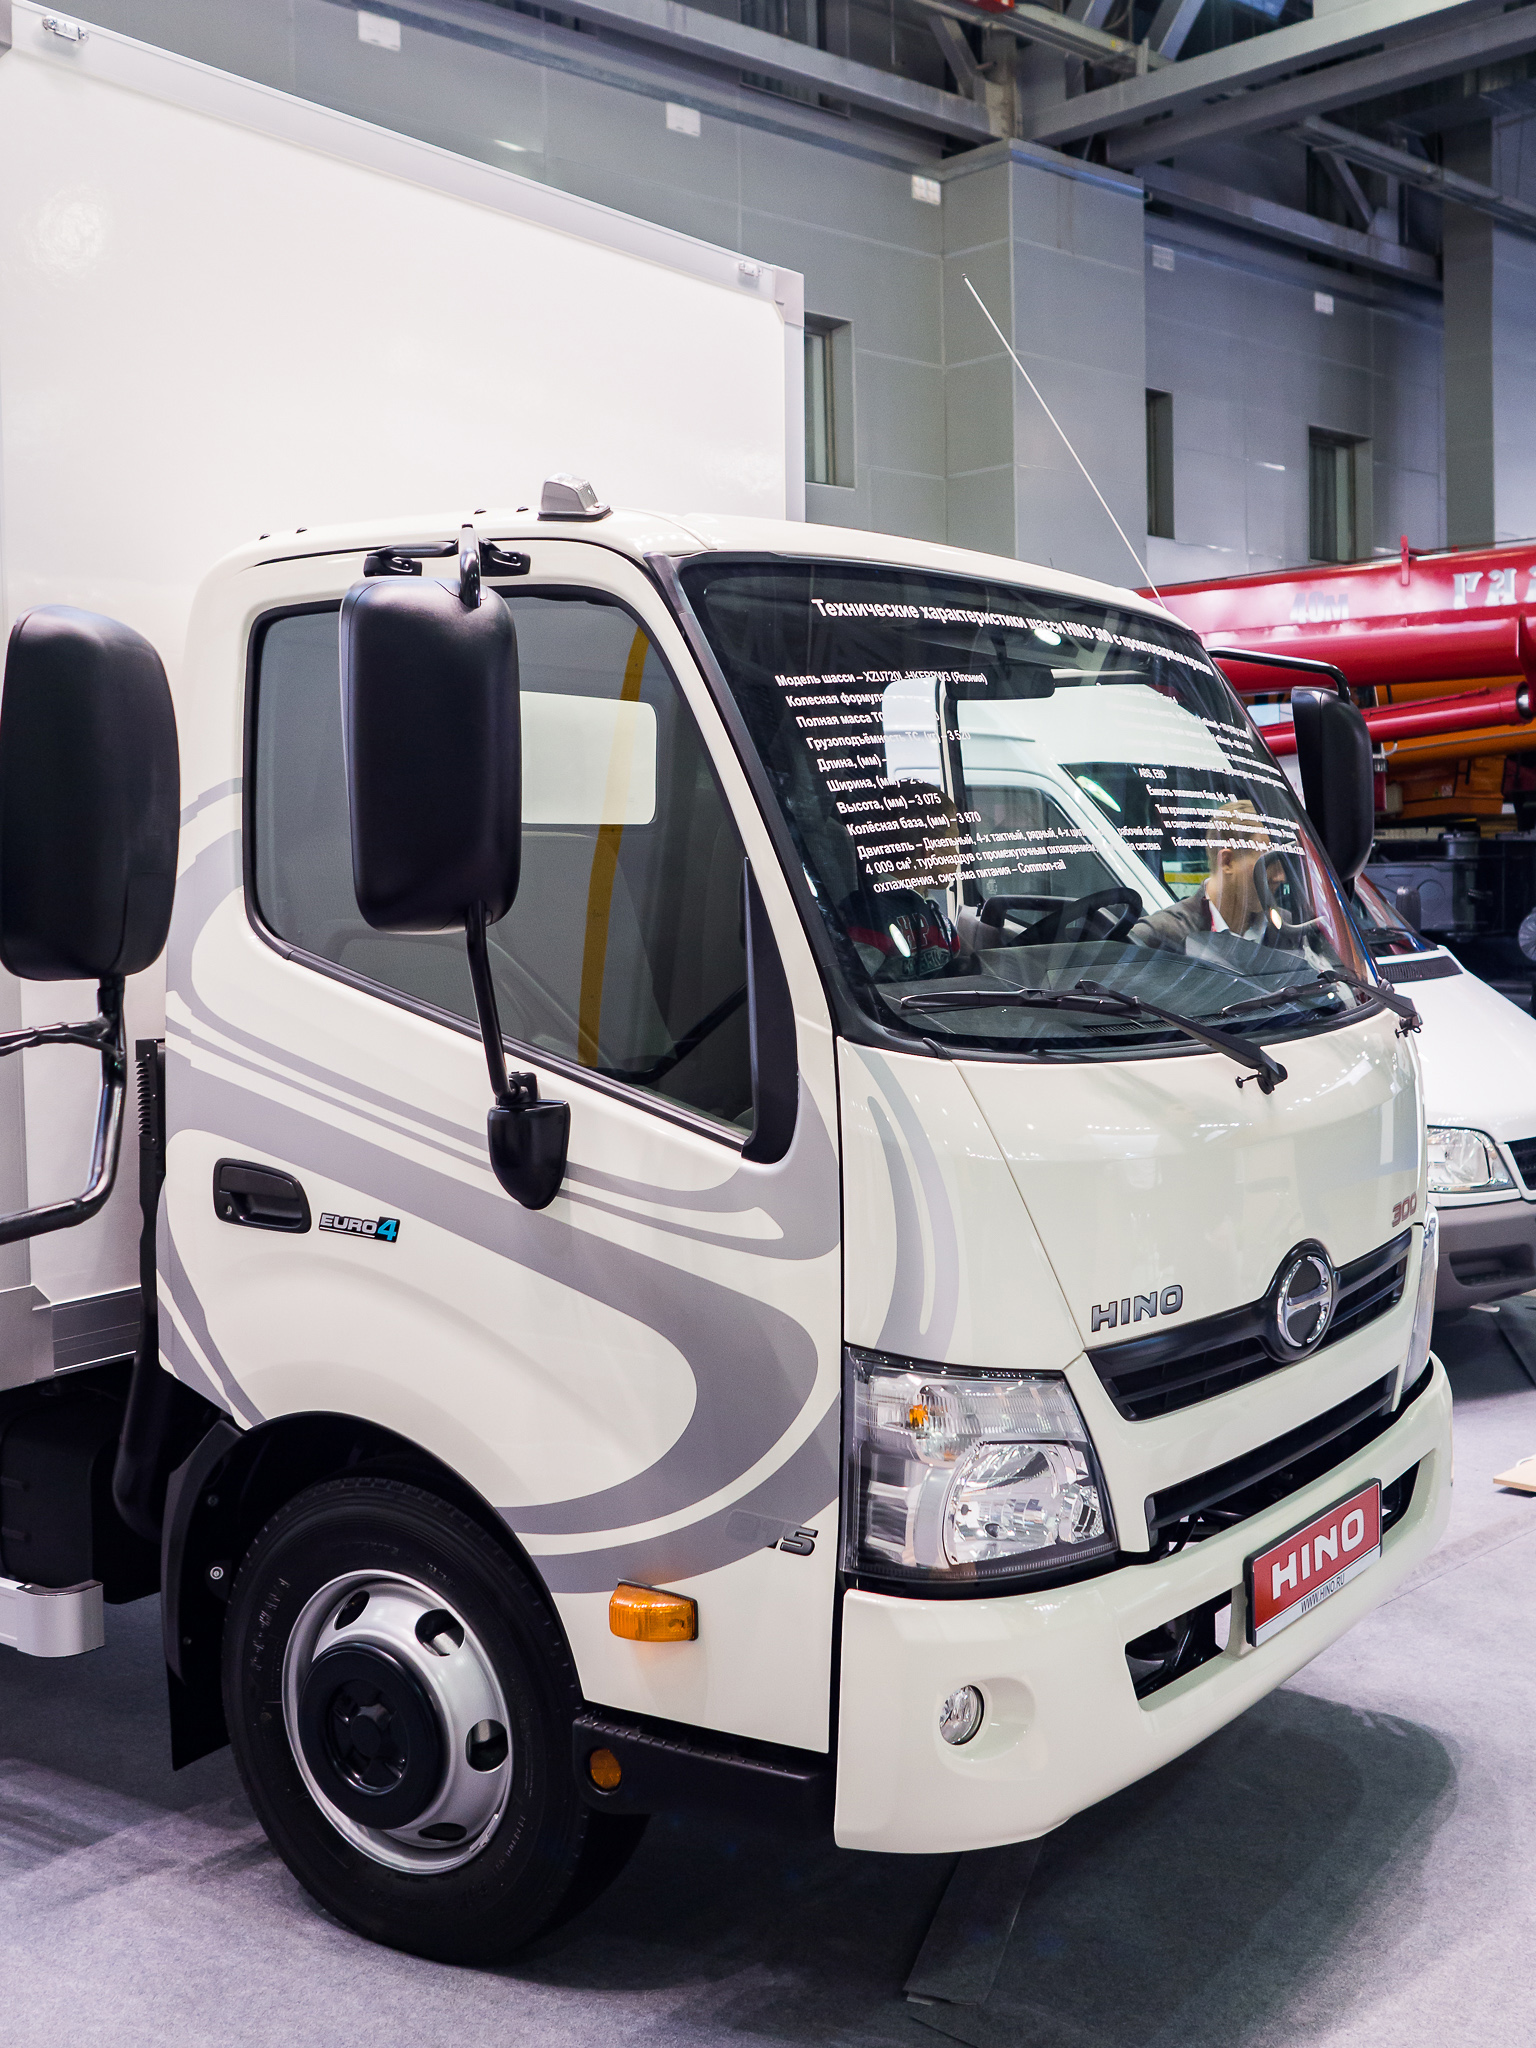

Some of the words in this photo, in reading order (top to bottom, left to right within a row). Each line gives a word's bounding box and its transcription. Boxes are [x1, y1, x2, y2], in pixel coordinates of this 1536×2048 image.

[1453, 565, 1536, 610] ГА
[811, 598, 919, 619] Технические
[919, 606, 1028, 629] характеристики
[1026, 617, 1066, 635] шасси
[1062, 620, 1094, 640] HINO
[775, 674, 821, 687] Модель
[821, 673, 856, 684] шасси
[951, 671, 989, 686] (Япония)
[785, 694, 840, 708] Колесная
[795, 715, 840, 728] Полная
[840, 714, 872, 725] масса
[816, 757, 858, 773] Длина,
[856, 753, 882, 769] (мм)
[826, 777, 877, 793] Ширина,
[836, 798, 885, 815] Высота,
[883, 795, 909, 811] (мм)
[846, 819, 900, 836] Колёсная
[900, 815, 928, 830] база,
[926, 813, 951, 829] (мм)
[857, 841, 915, 860] Двигатель
[922, 833, 977, 851] Дизельный,
[991, 828, 1027, 843] тактный,
[1025, 826, 1059, 843] рядный,
[915, 852, 976, 870] турбонаддув
[982, 847, 1048, 863] промежуточным
[873, 875, 938, 894] охлаждения,
[937, 870, 976, 885] система
[975, 866, 1012, 879] питания
[1017, 858, 1067, 874] Common-rail
[1391, 1190, 1418, 1228] 300
[1091, 1284, 1184, 1333] HINO
[1271, 1508, 1365, 1600] HINO
[1300, 1573, 1345, 1614] WWW.HINO.RU
